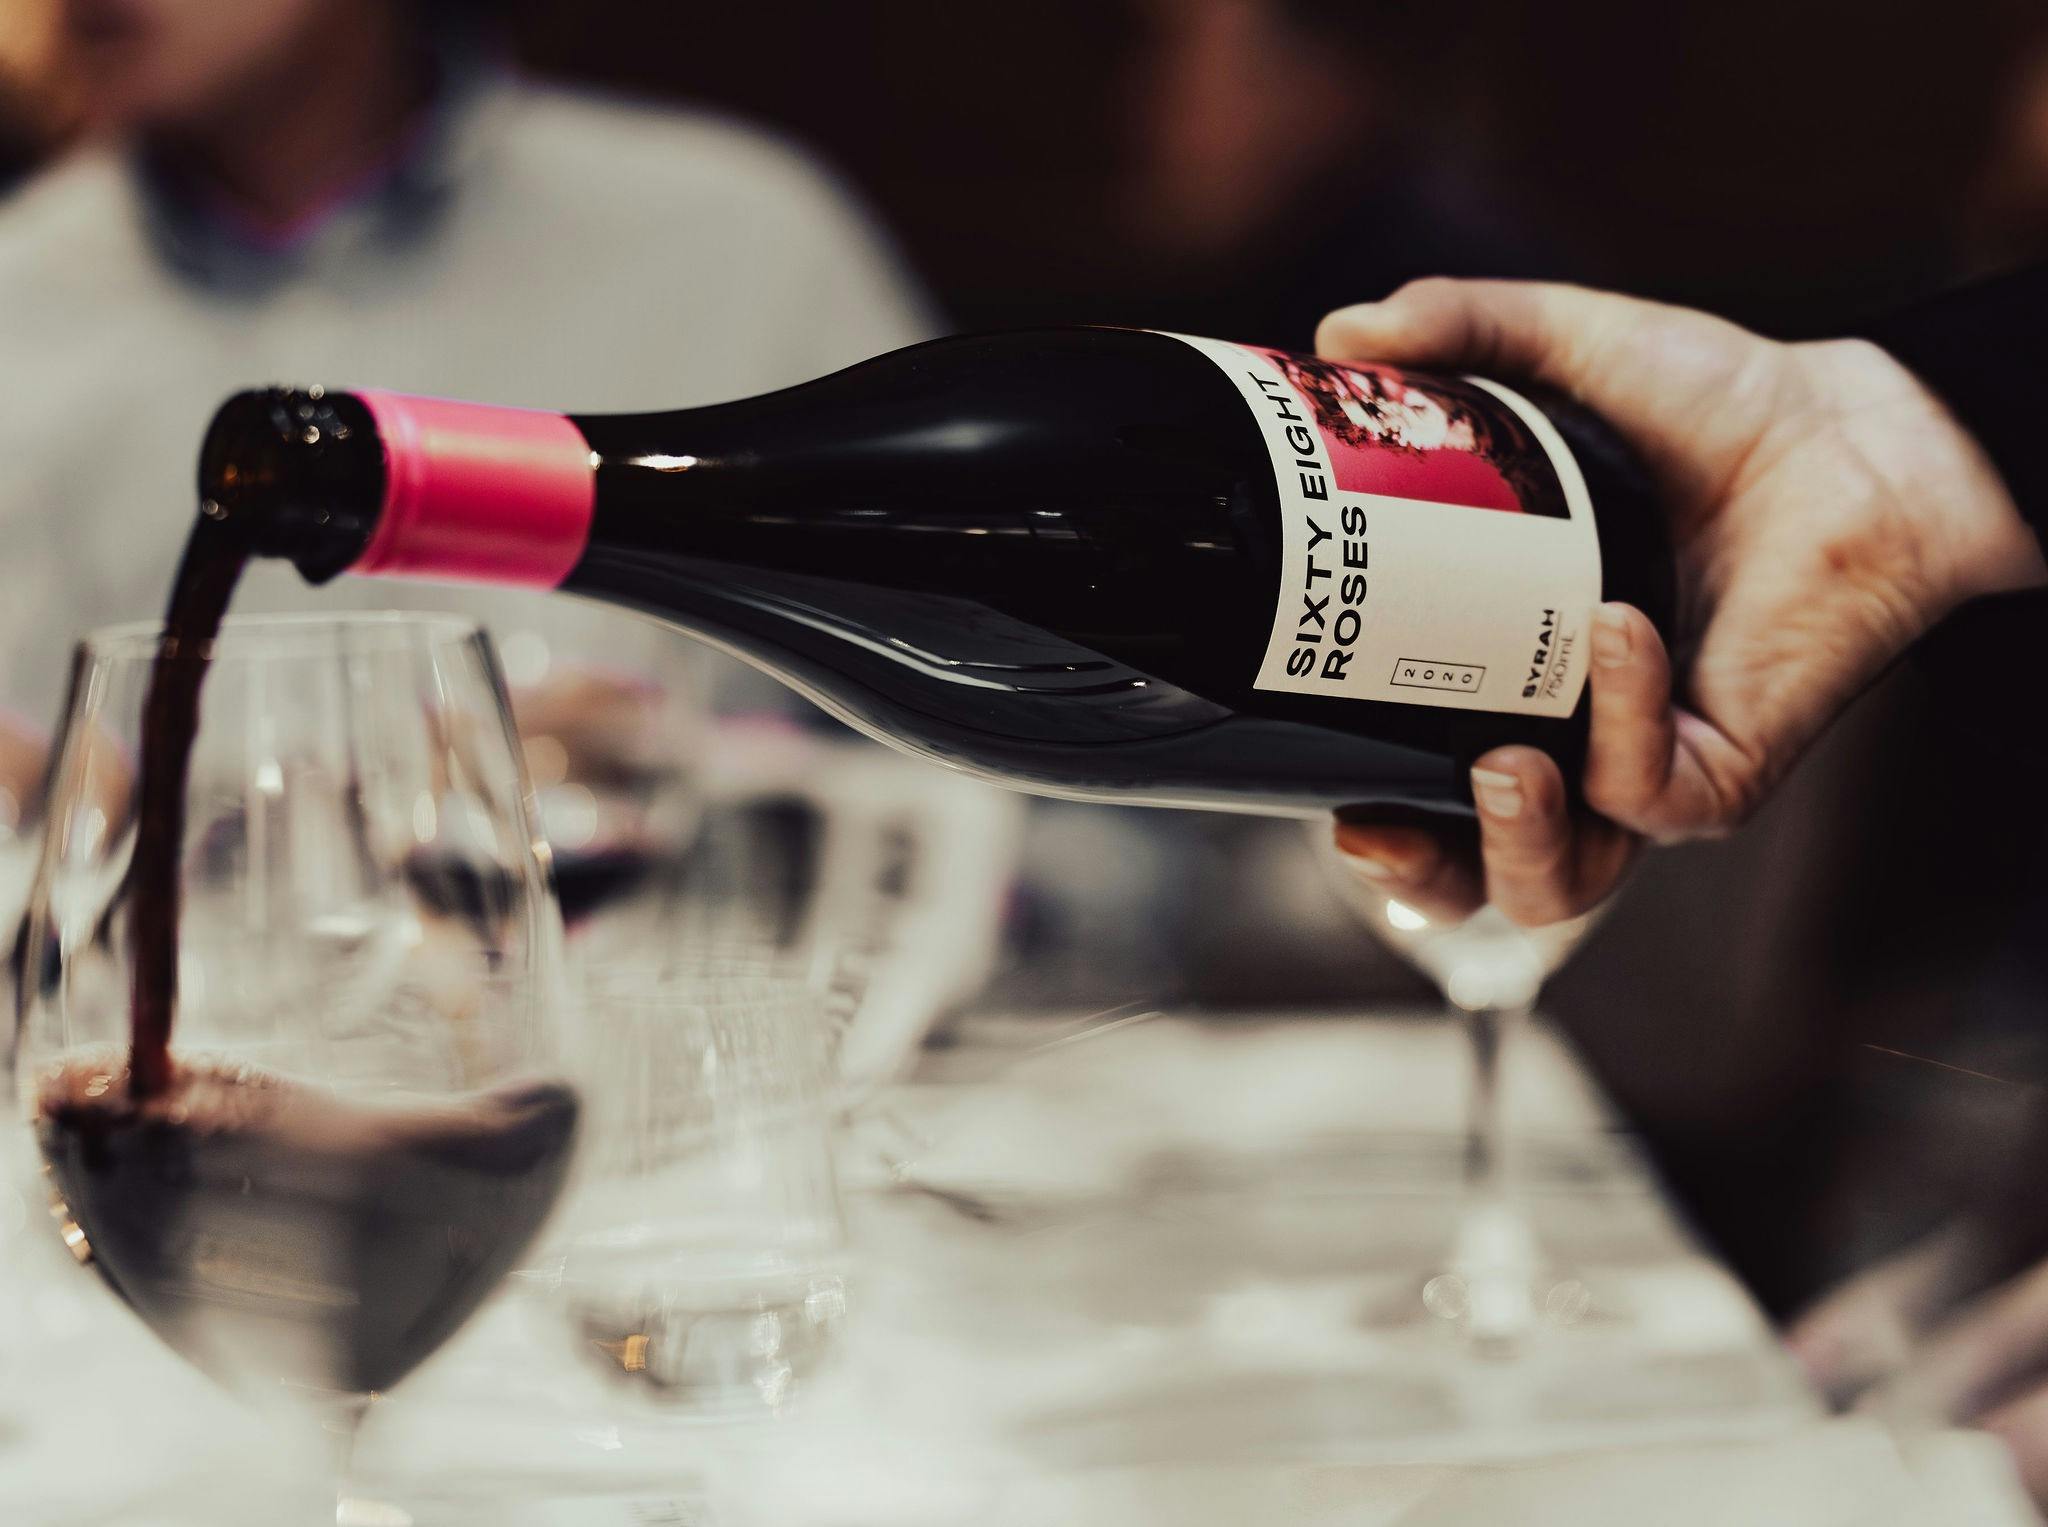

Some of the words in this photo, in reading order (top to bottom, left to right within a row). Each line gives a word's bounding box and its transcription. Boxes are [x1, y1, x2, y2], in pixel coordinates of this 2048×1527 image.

[1248, 370, 1328, 501] EIGHT
[1286, 515, 1332, 678] SIXTY
[1320, 505, 1367, 680] ROSES
[1522, 609, 1555, 698] SYRAH
[1404, 668, 1473, 684] 2020
